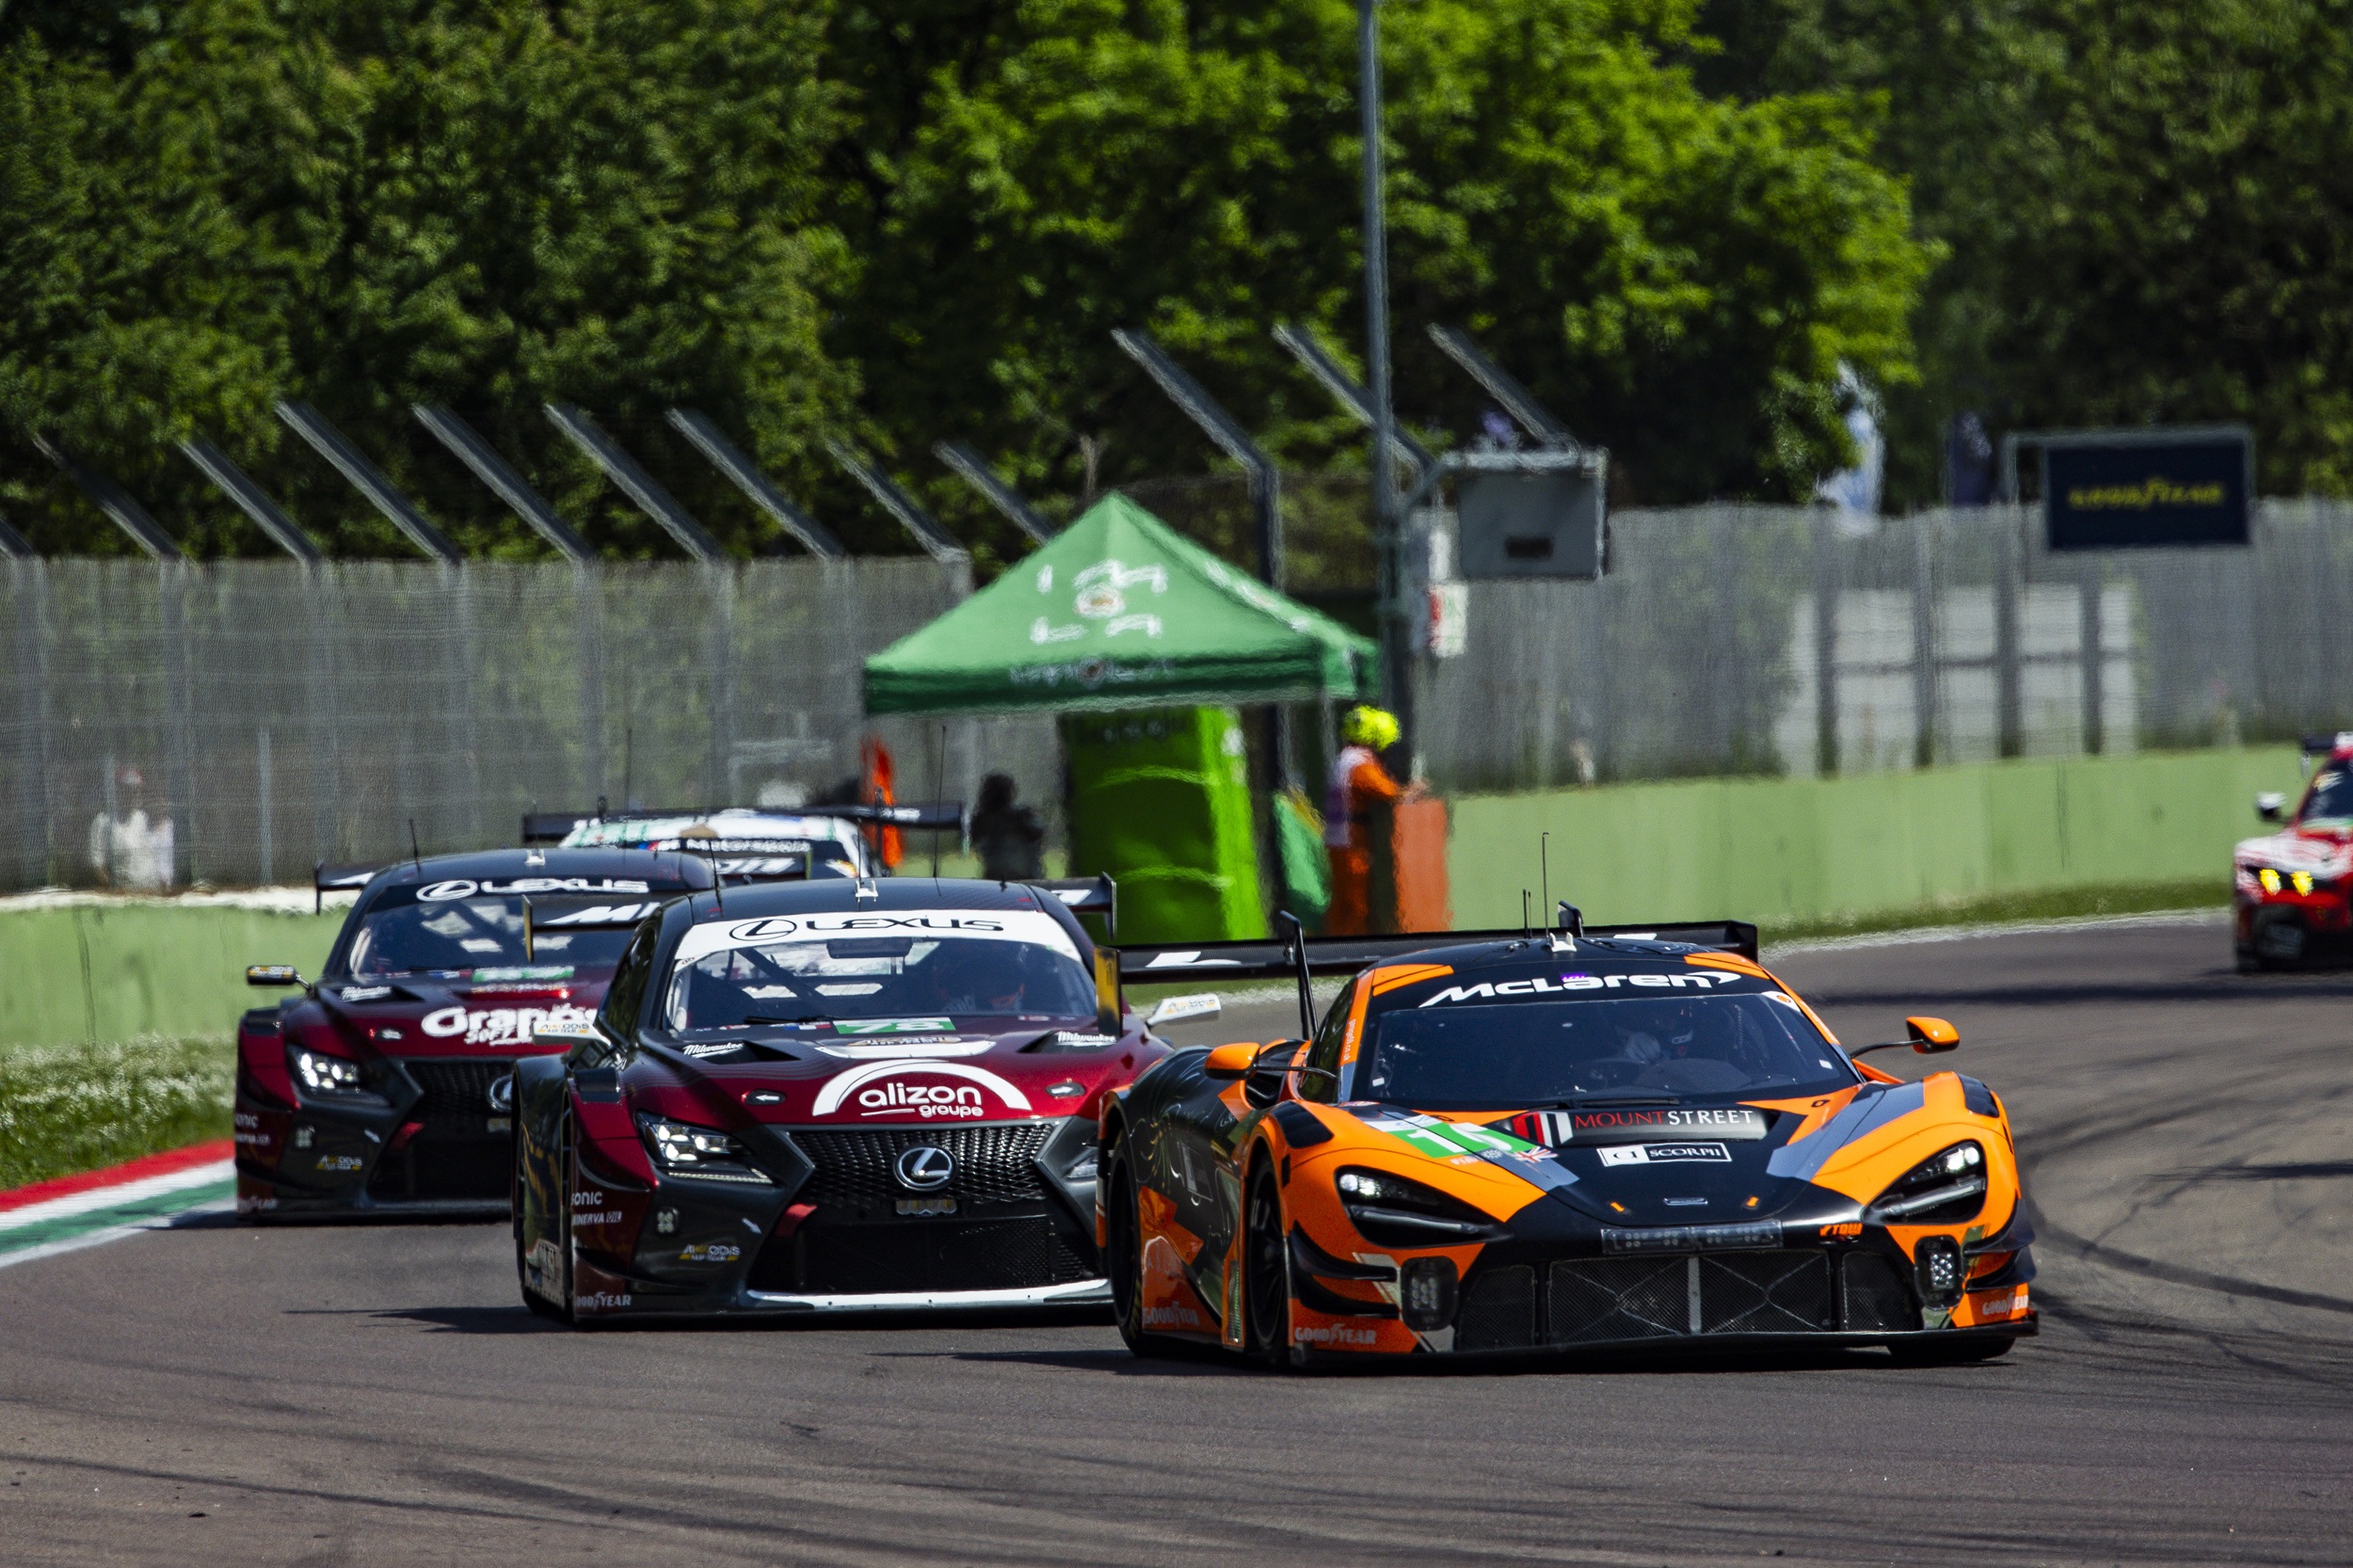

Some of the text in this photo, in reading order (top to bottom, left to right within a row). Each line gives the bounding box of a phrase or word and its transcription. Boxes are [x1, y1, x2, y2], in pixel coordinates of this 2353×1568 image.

[481, 878, 649, 893] LEXUS
[805, 918, 1004, 931] LEXUS
[1418, 972, 1741, 1007] McLaren
[845, 1021, 944, 1033] 78
[682, 1042, 744, 1058] Milwaukee
[858, 1082, 982, 1108] alizon
[918, 1105, 984, 1118] groupe
[1295, 1323, 1376, 1345] GOODYEAR
